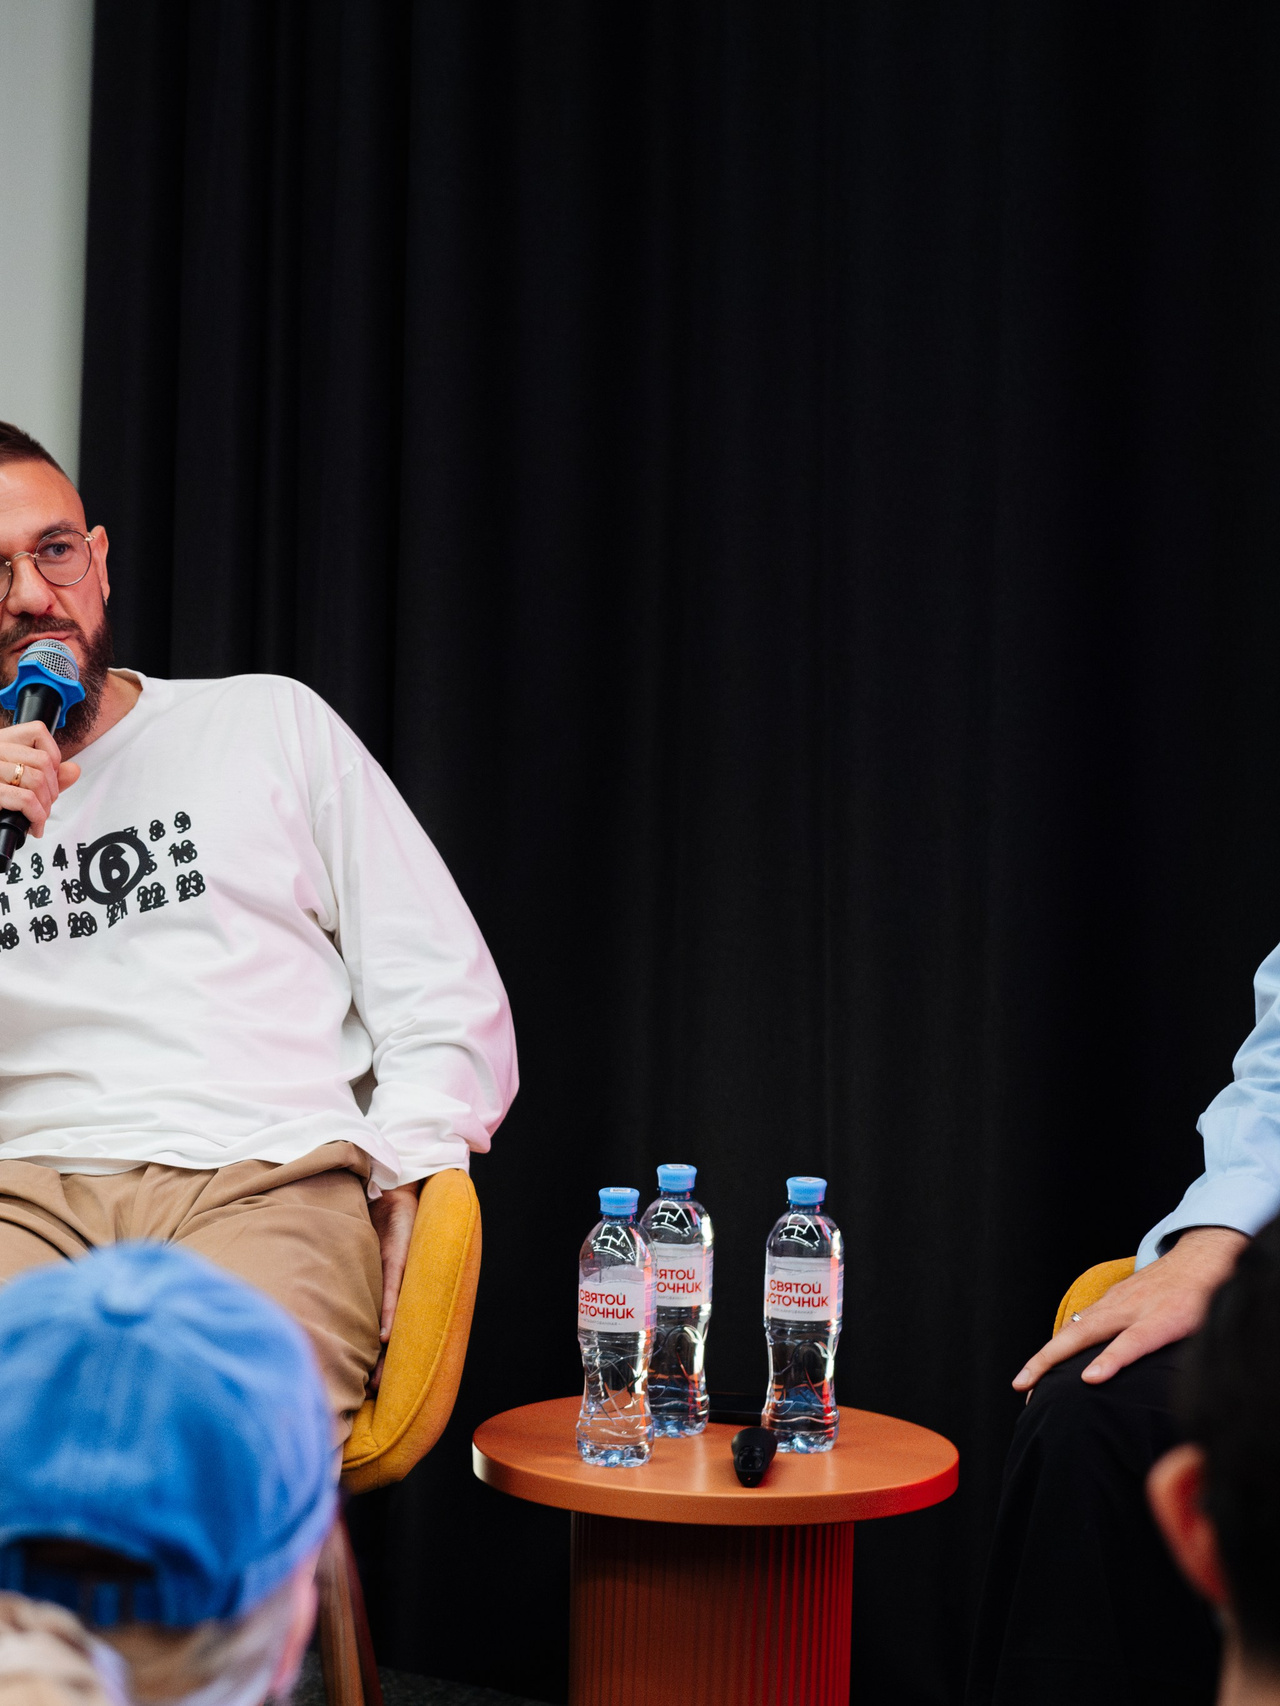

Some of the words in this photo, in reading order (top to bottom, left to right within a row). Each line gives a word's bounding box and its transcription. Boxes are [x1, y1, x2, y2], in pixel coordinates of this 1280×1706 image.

[5, 862, 23, 885] 2
[31, 852, 44, 879] 3
[52, 843, 69, 871] 4
[99, 843, 130, 893] 6
[149, 819, 166, 842] 8
[174, 811, 191, 834] 9
[24, 885, 53, 910] 12
[29, 914, 59, 944] 19
[67, 911, 98, 939] 20
[136, 881, 169, 914] 22
[176, 870, 206, 903] 23
[656, 1267, 696, 1281] ЯТОЙ
[656, 1281, 702, 1294] ОЧНИК
[578, 1302, 635, 1320] СТОЧНИК
